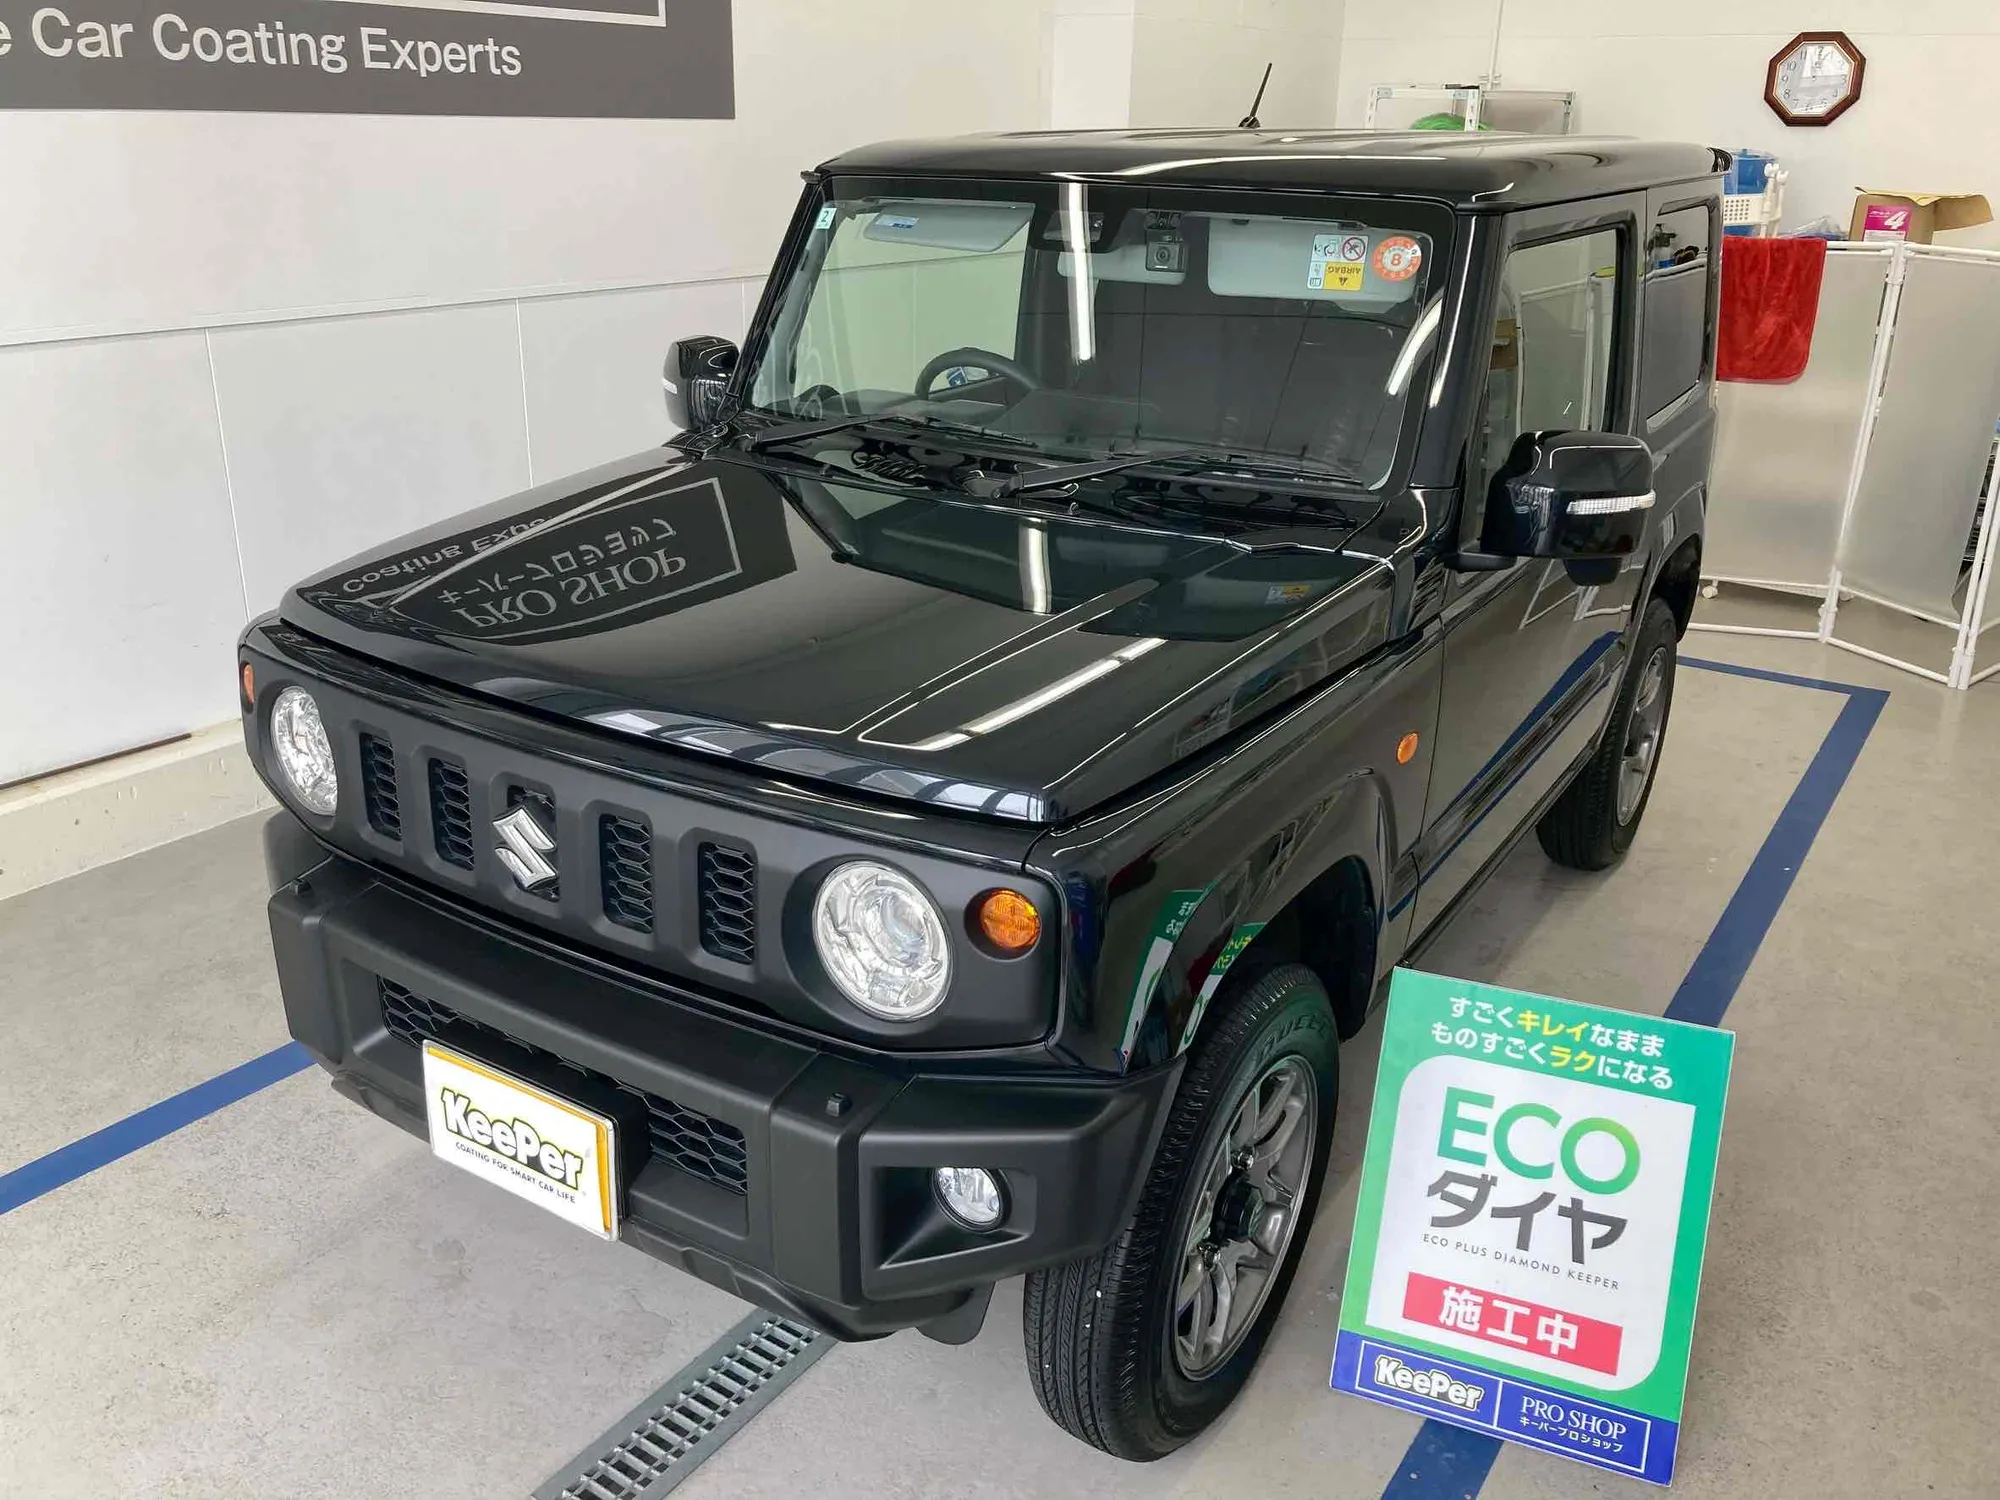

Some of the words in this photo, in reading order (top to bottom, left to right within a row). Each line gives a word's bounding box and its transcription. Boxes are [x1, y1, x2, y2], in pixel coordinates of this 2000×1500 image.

[32, 7, 133, 58] Car
[152, 13, 348, 74] Coating
[360, 26, 522, 77] Experts
[1782, 88, 1791, 99] 8
[820, 210, 830, 223] 2
[1884, 210, 1908, 229] 4
[1328, 265, 1361, 274] AIRBAG
[1391, 253, 1401, 266] 8
[1430, 1021, 1674, 1091] ものすごくラクになる
[1448, 996, 1666, 1058] すごくキレイなまま
[441, 1087, 584, 1190] KeePer
[1437, 1086, 1641, 1196] ECO
[455, 1141, 490, 1163] COATING
[492, 1157, 509, 1173] FOR
[510, 1166, 536, 1185] SMART
[538, 1180, 554, 1194] CAR
[556, 1189, 576, 1204] LIFE
[1427, 1170, 1629, 1265] ダイヤ
[1423, 1233, 1449, 1248] ECO
[1455, 1241, 1488, 1257] PLUS
[1494, 1250, 1560, 1276] DIAMOND
[1567, 1269, 1619, 1291] KEEPER
[1438, 1285, 1579, 1356] 施工中
[1374, 1354, 1485, 1412] KeePer
[1518, 1415, 1624, 1454] キーパープロショップ
[1520, 1395, 1565, 1424] PRO
[1567, 1410, 1627, 1441] SHOP
